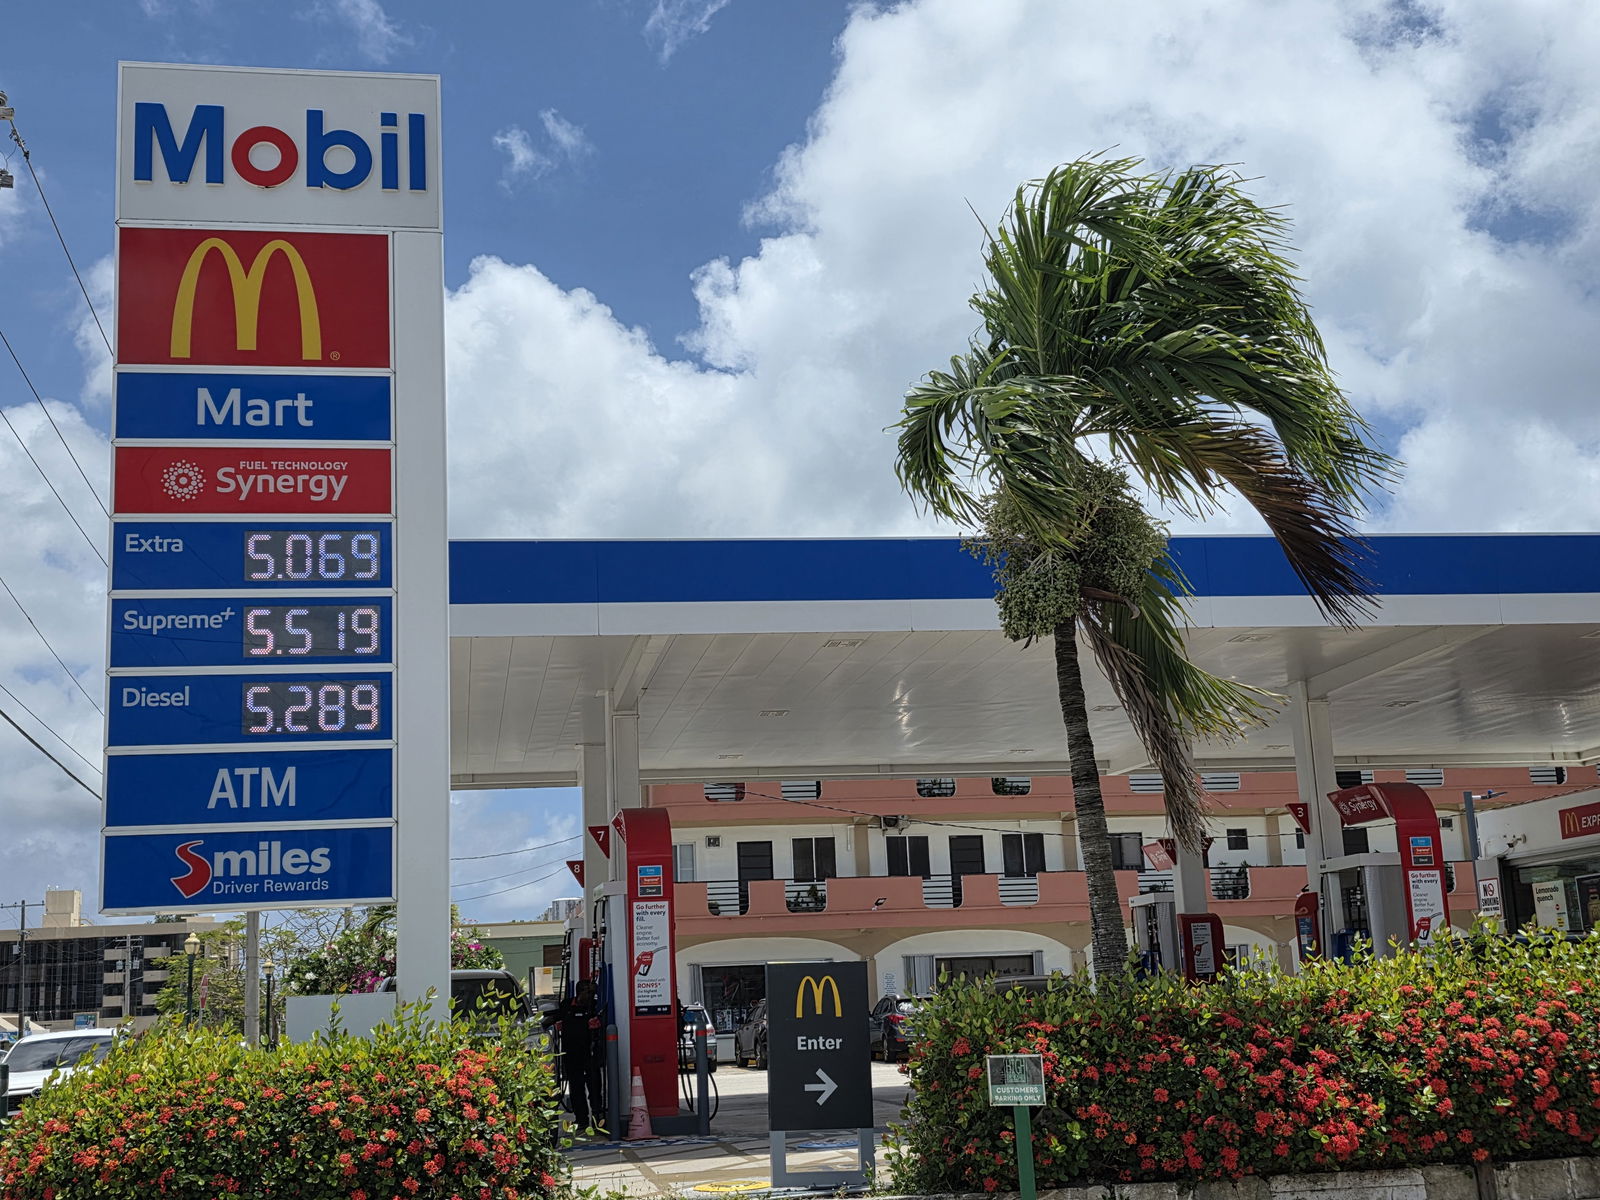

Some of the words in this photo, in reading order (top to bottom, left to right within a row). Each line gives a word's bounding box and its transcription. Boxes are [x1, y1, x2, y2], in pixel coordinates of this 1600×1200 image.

[133, 101, 428, 192] Mobil
[197, 387, 314, 427] Mart
[239, 460, 269, 471] FUEL
[271, 461, 349, 472] TECHNOLOGY
[216, 467, 349, 502] Synergy
[125, 533, 184, 554] Extra
[248, 533, 378, 580] 5.069
[246, 608, 378, 655] 5.519
[122, 686, 190, 708] Diesel
[246, 684, 379, 733] 5.289
[207, 766, 296, 809] ATM
[1297, 806, 1304, 818] 3
[1348, 799, 1378, 814] Synergy
[597, 830, 605, 842] 7
[170, 839, 331, 899] Smiles
[573, 864, 580, 873] 8
[213, 879, 260, 895] Driver
[263, 878, 329, 893] Rewards
[1535, 884, 1560, 895] Lemonade
[1536, 894, 1554, 904] quench
[797, 1036, 842, 1050] Enter
[996, 1086, 1039, 1094] CUSTOMERS
